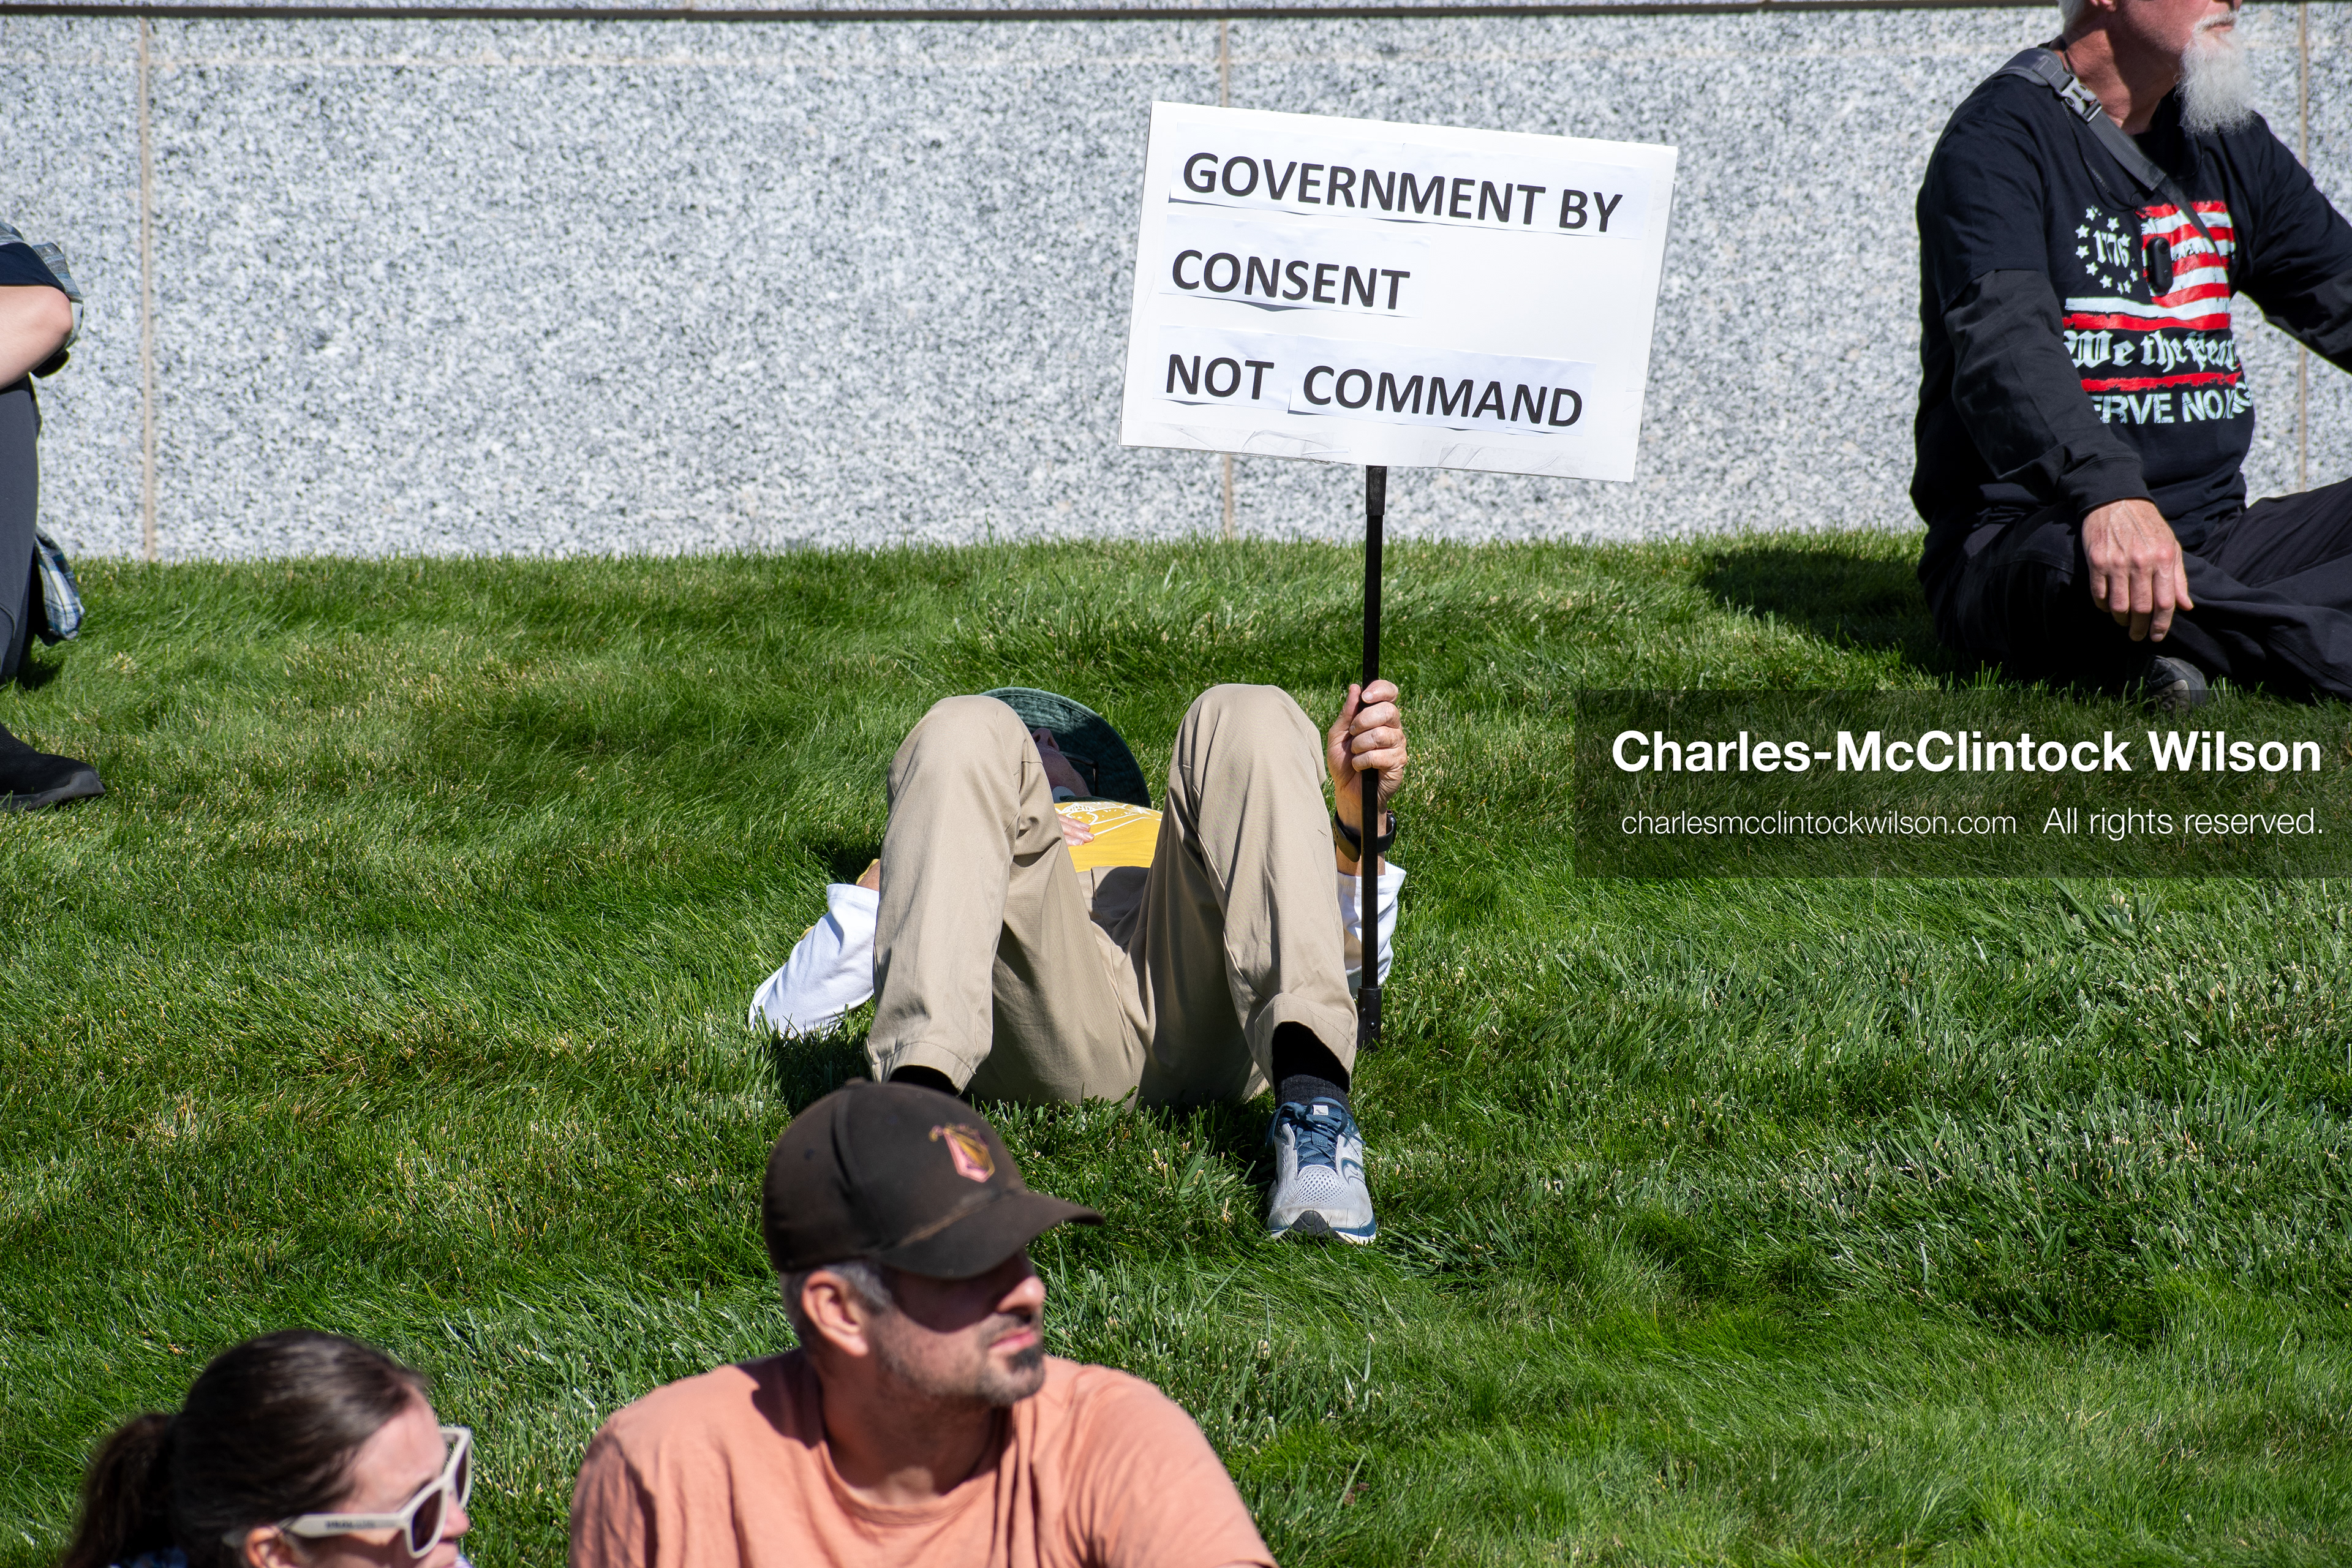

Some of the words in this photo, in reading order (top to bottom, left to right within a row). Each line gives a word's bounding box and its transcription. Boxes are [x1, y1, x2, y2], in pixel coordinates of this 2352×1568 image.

[1183, 153, 1546, 225] GOVERNMENT
[1559, 189, 1623, 233] BY
[1172, 249, 1411, 310] CONSENT
[2063, 330, 2136, 369] We
[2140, 330, 2188, 373] the
[2183, 331, 2238, 372] Peop
[1166, 353, 1275, 401] NOT
[1303, 365, 1583, 428] COMMAND
